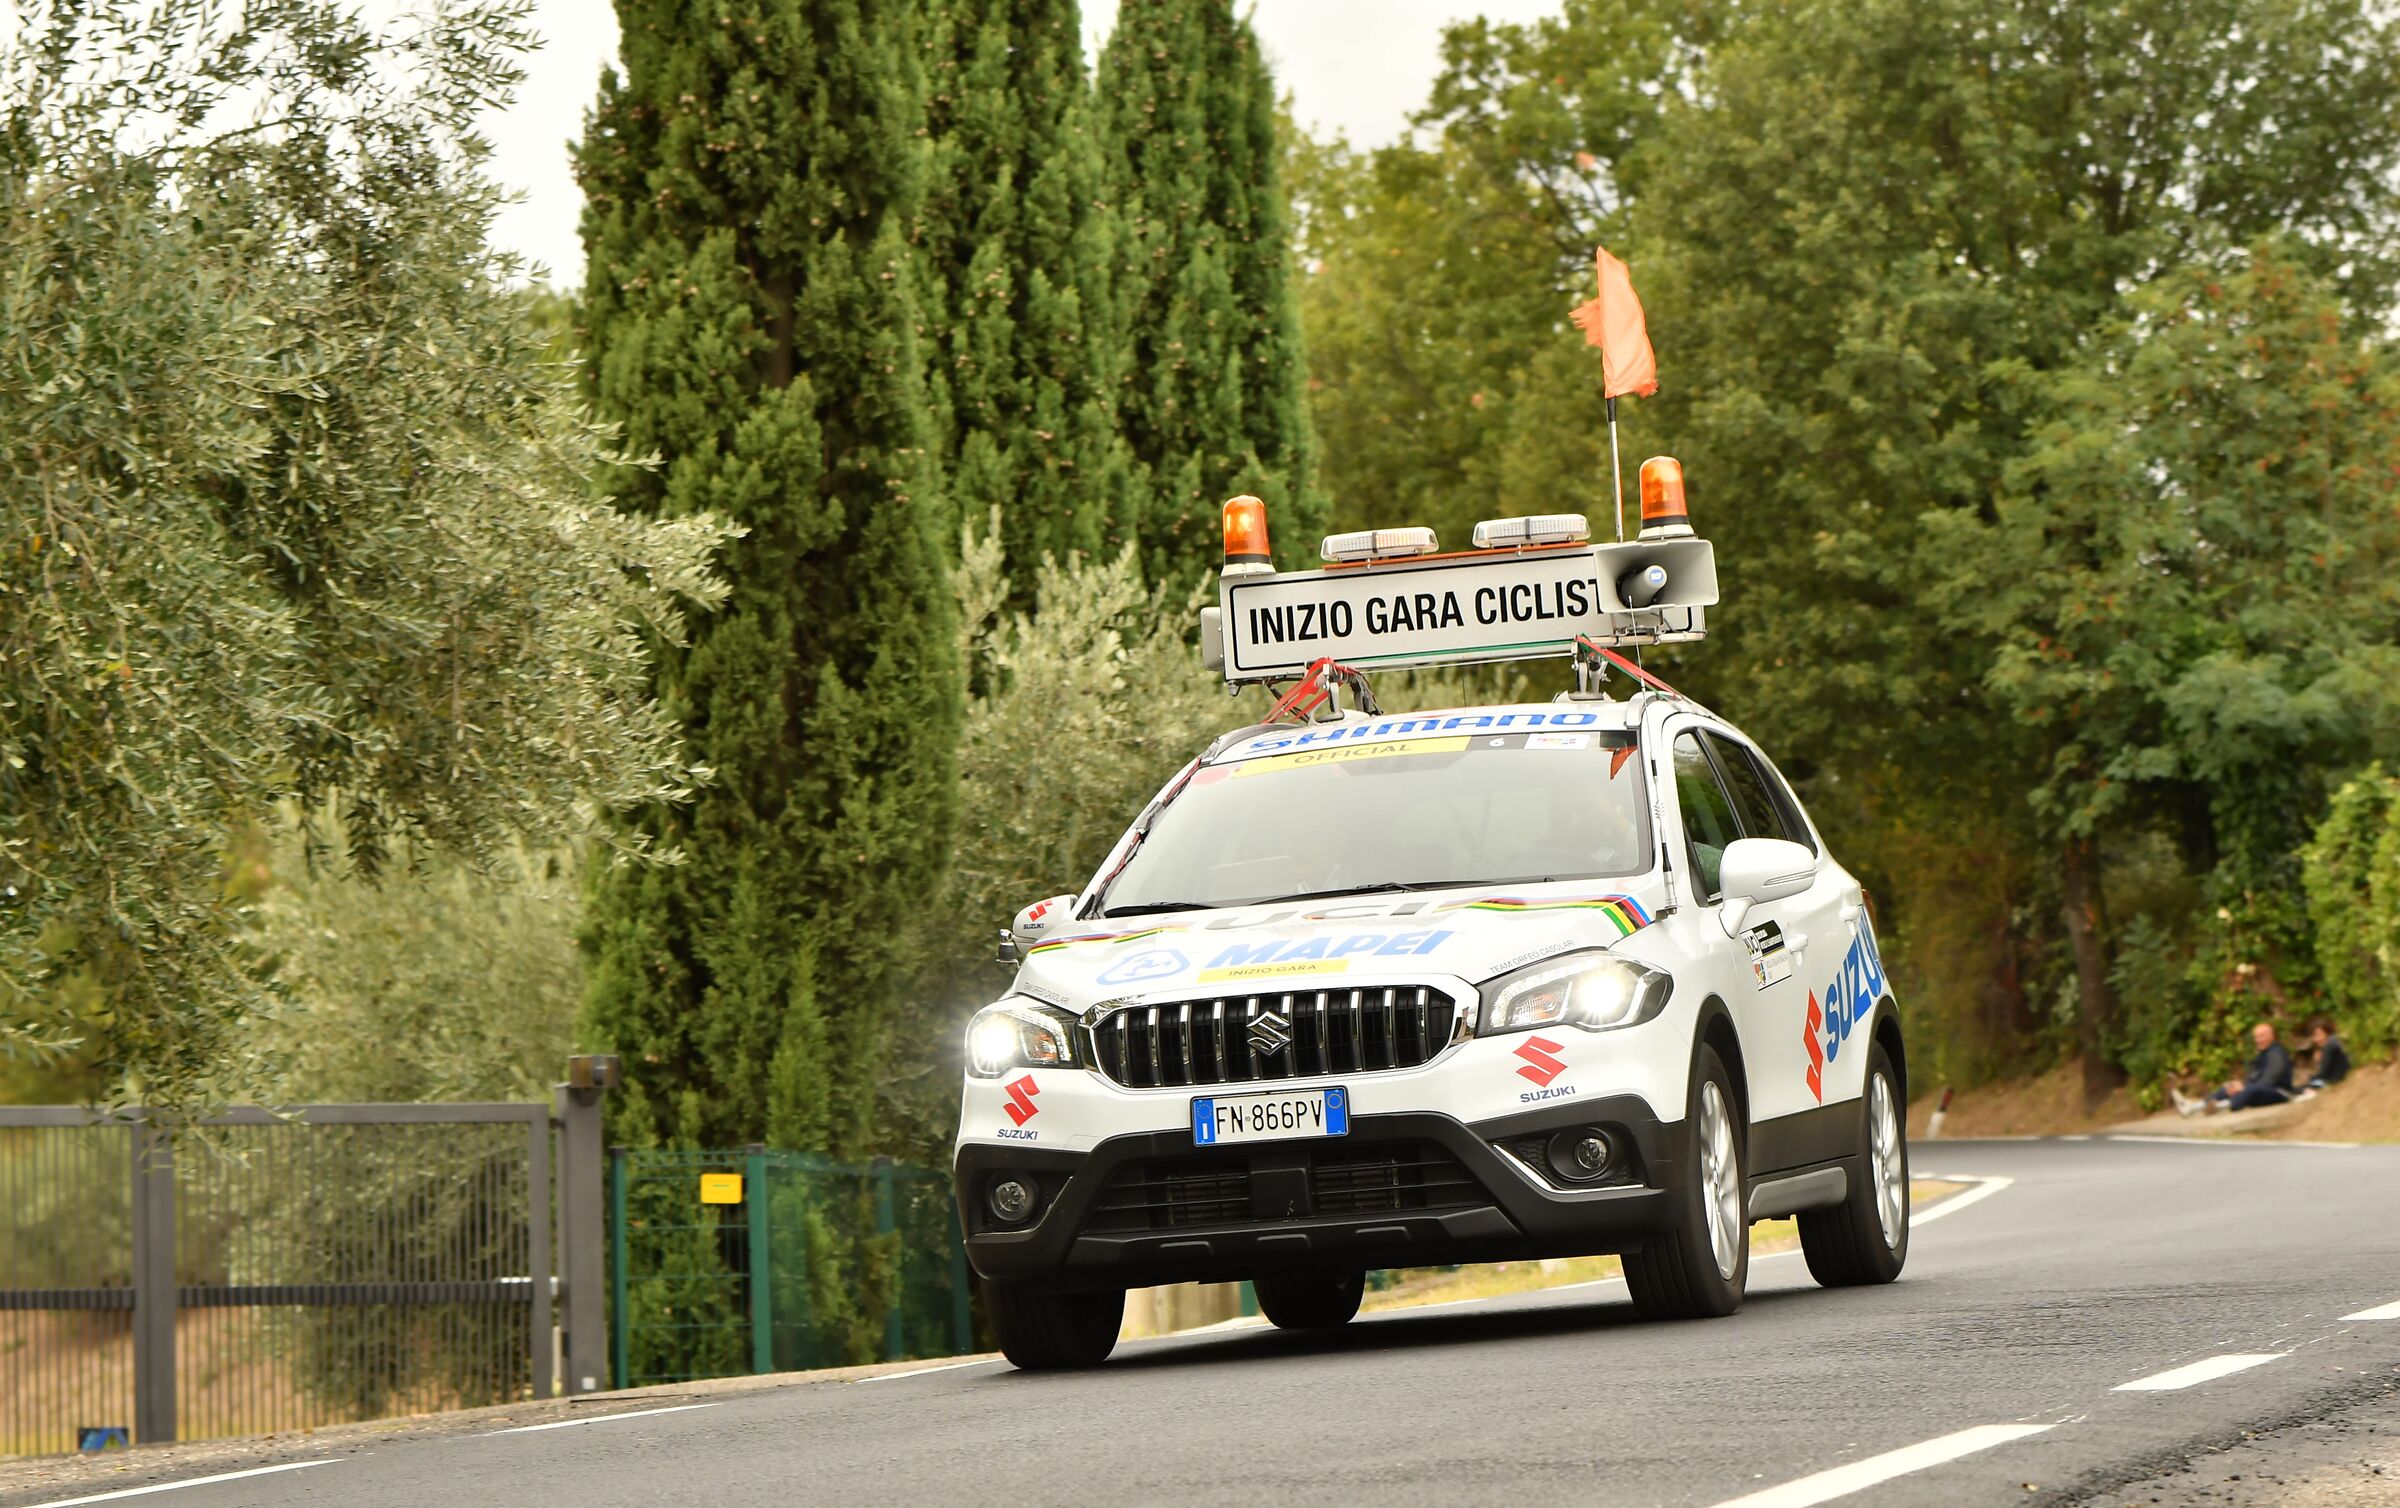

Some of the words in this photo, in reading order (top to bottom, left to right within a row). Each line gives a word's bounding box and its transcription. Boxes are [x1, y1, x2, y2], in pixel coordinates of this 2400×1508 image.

[1249, 600, 1353, 645] INIZIO
[1365, 590, 1465, 635] GARA
[1246, 711, 1598, 755] SHIMANO
[1293, 743, 1413, 765] OFFICIAL
[1023, 922, 1045, 930] SUZUKI
[1203, 929, 1456, 969] MAPEI
[1228, 966, 1272, 977] INIZIO
[1276, 963, 1317, 974] GARA
[1489, 960, 1513, 974] TEAM
[1519, 1085, 1577, 1103] SUZUKI
[996, 1128, 1039, 1141] SUZUKI
